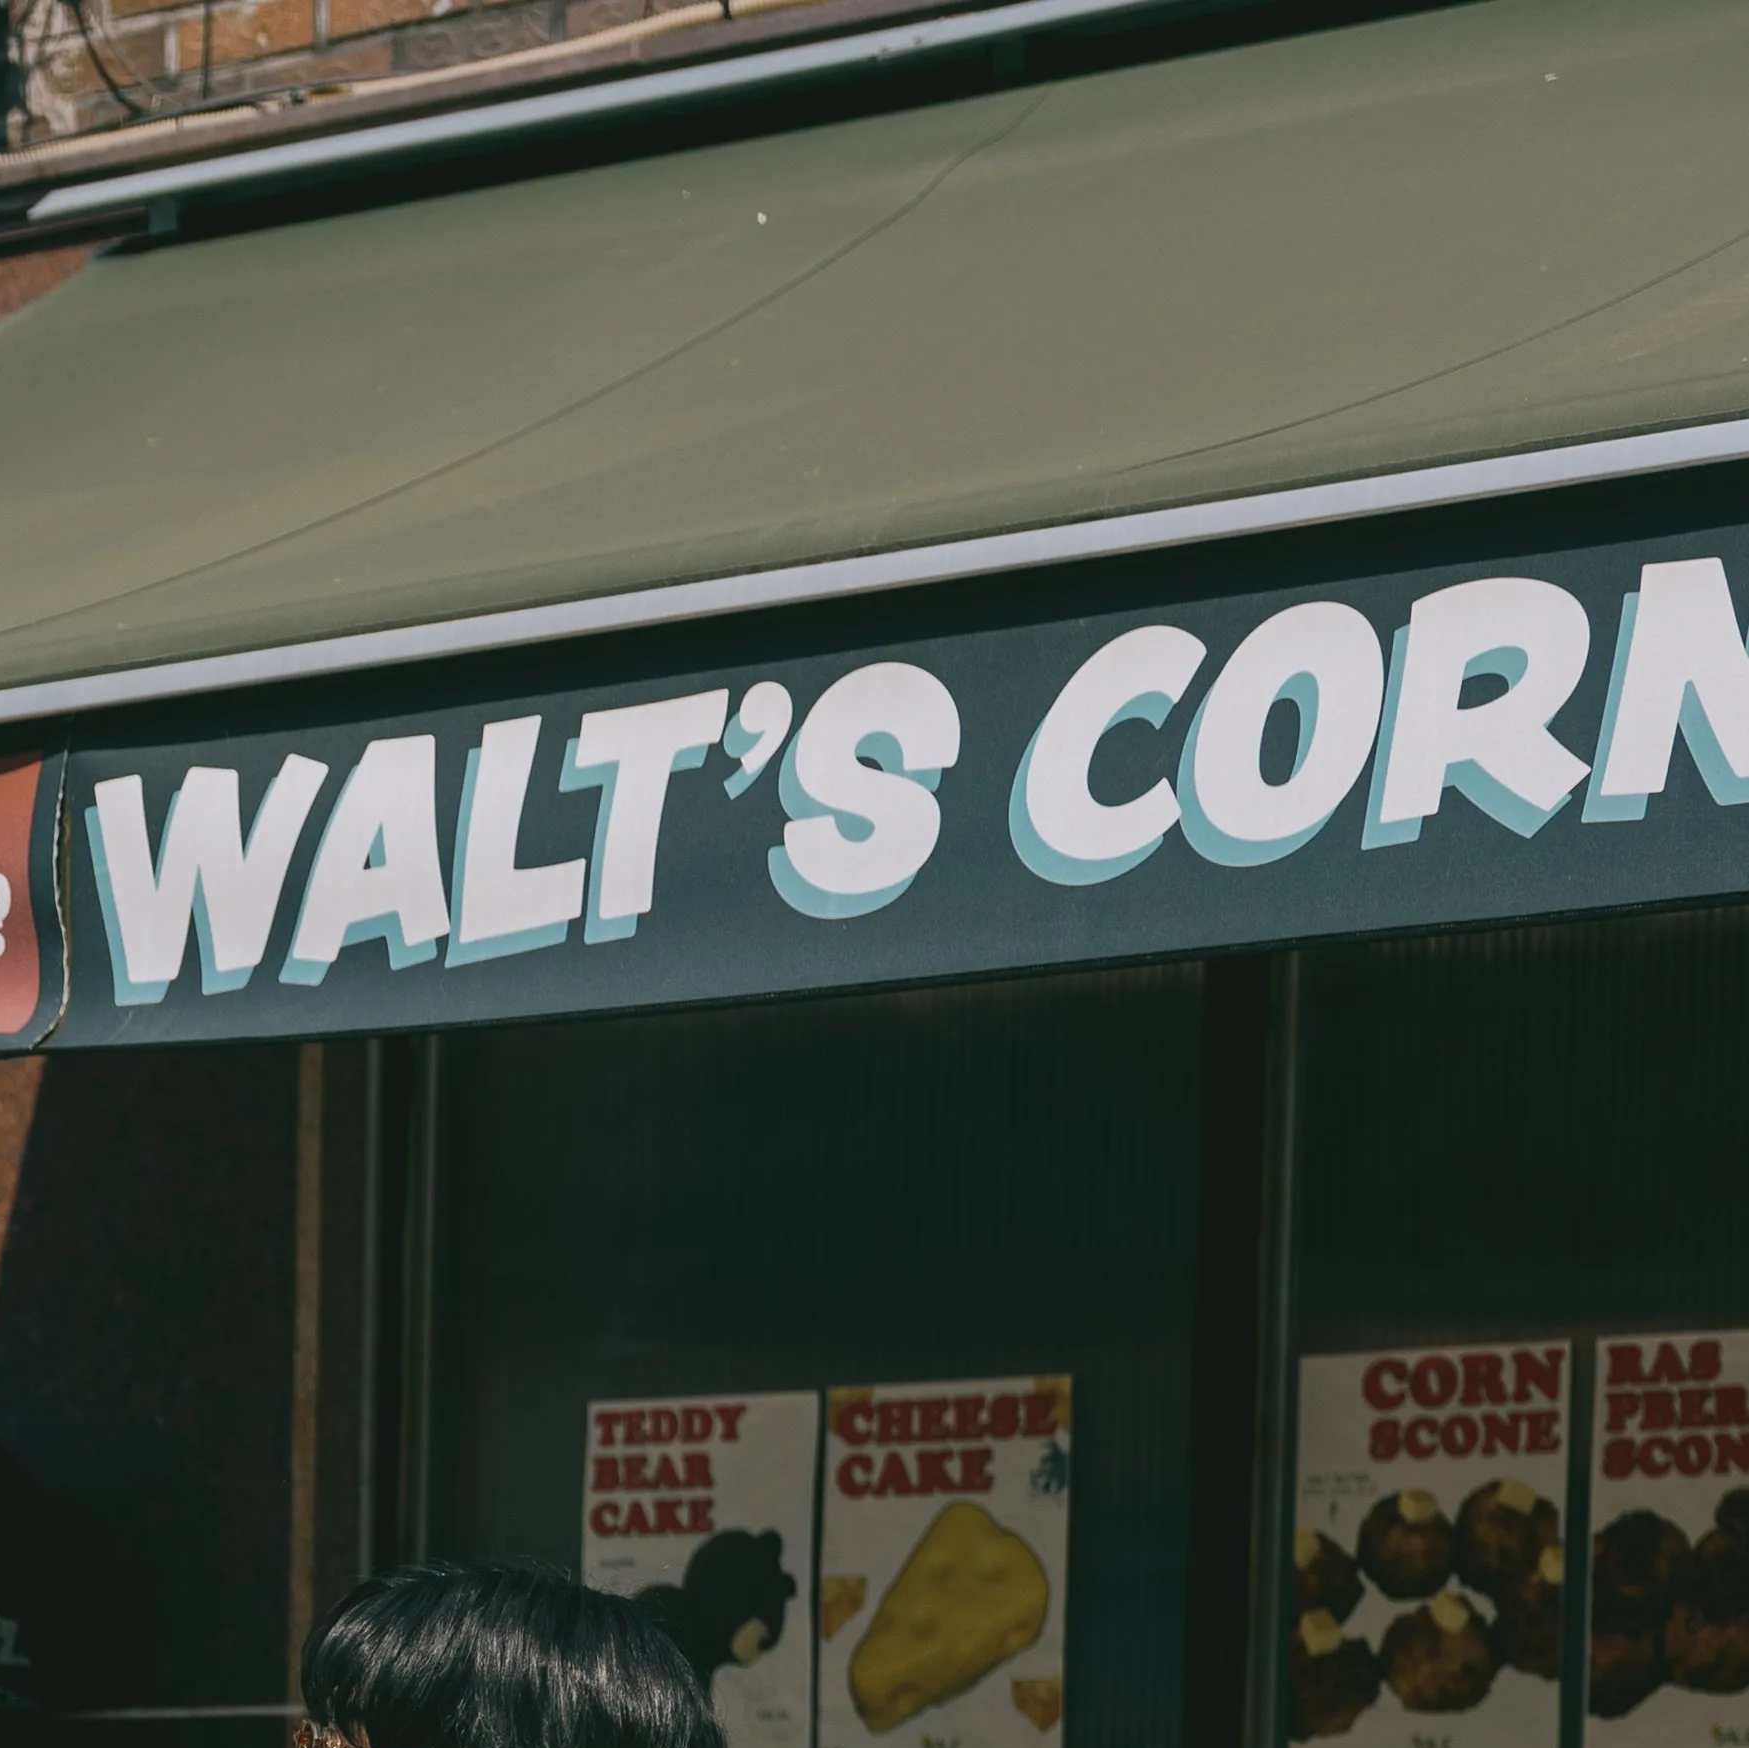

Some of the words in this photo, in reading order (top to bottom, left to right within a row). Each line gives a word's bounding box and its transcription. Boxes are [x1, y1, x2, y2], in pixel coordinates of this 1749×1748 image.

[86, 660, 961, 1008] WALT'S
[1362, 1349, 1567, 1411] CORN
[1607, 1339, 1722, 1386] RAS
[593, 1404, 747, 1447] TEDDY
[838, 1394, 1059, 1447] CHEESE
[1368, 1410, 1562, 1462] SCONE
[590, 1452, 715, 1493] BEAR
[836, 1447, 995, 1500] CAKE
[589, 1499, 715, 1539] CAKE
